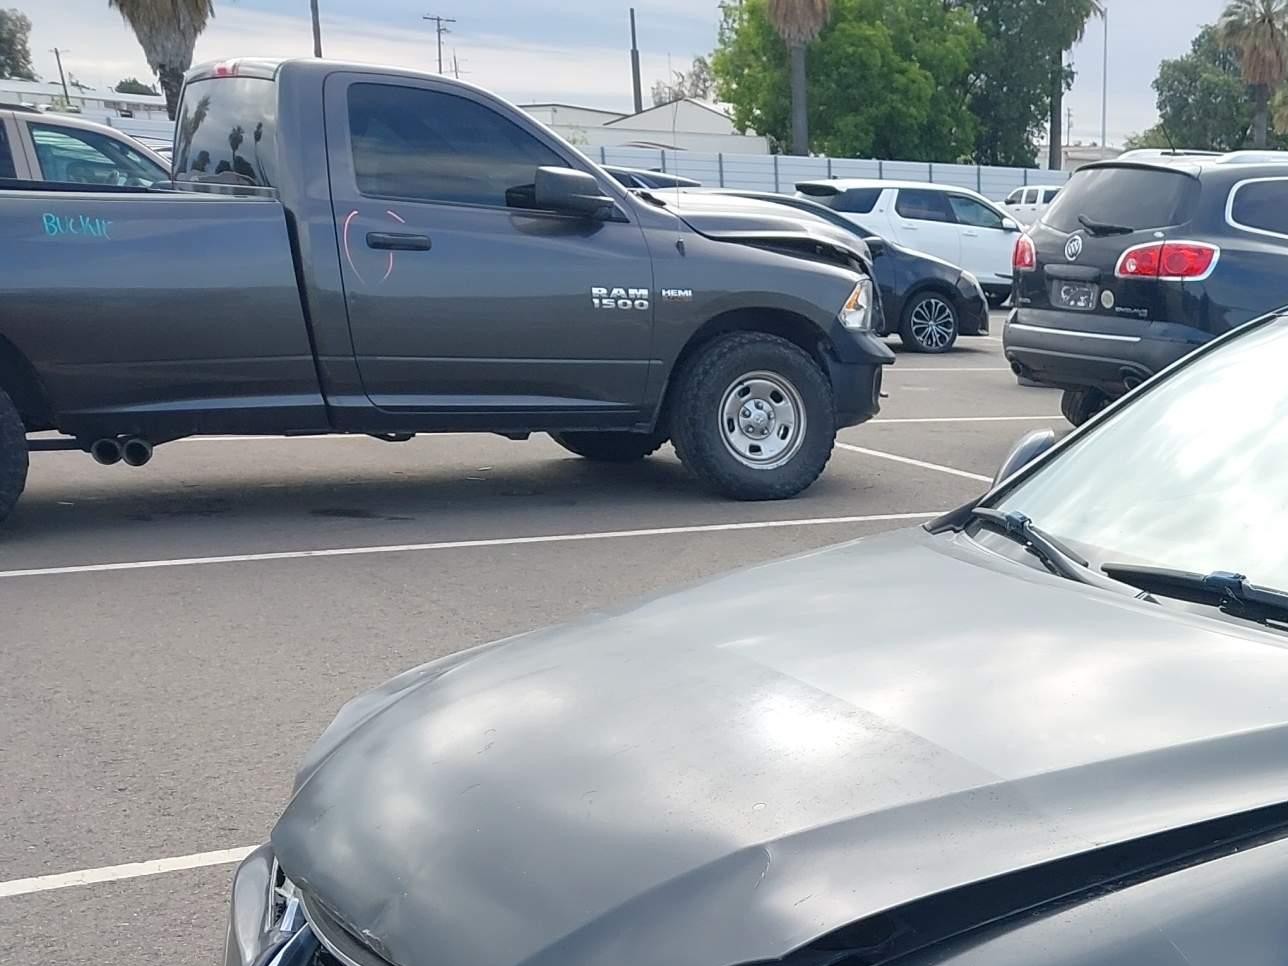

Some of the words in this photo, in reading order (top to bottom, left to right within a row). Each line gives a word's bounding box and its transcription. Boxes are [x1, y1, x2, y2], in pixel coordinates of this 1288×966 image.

[591, 287, 648, 299] RAM
[661, 289, 692, 297] HEMI
[591, 298, 649, 310] 1500
